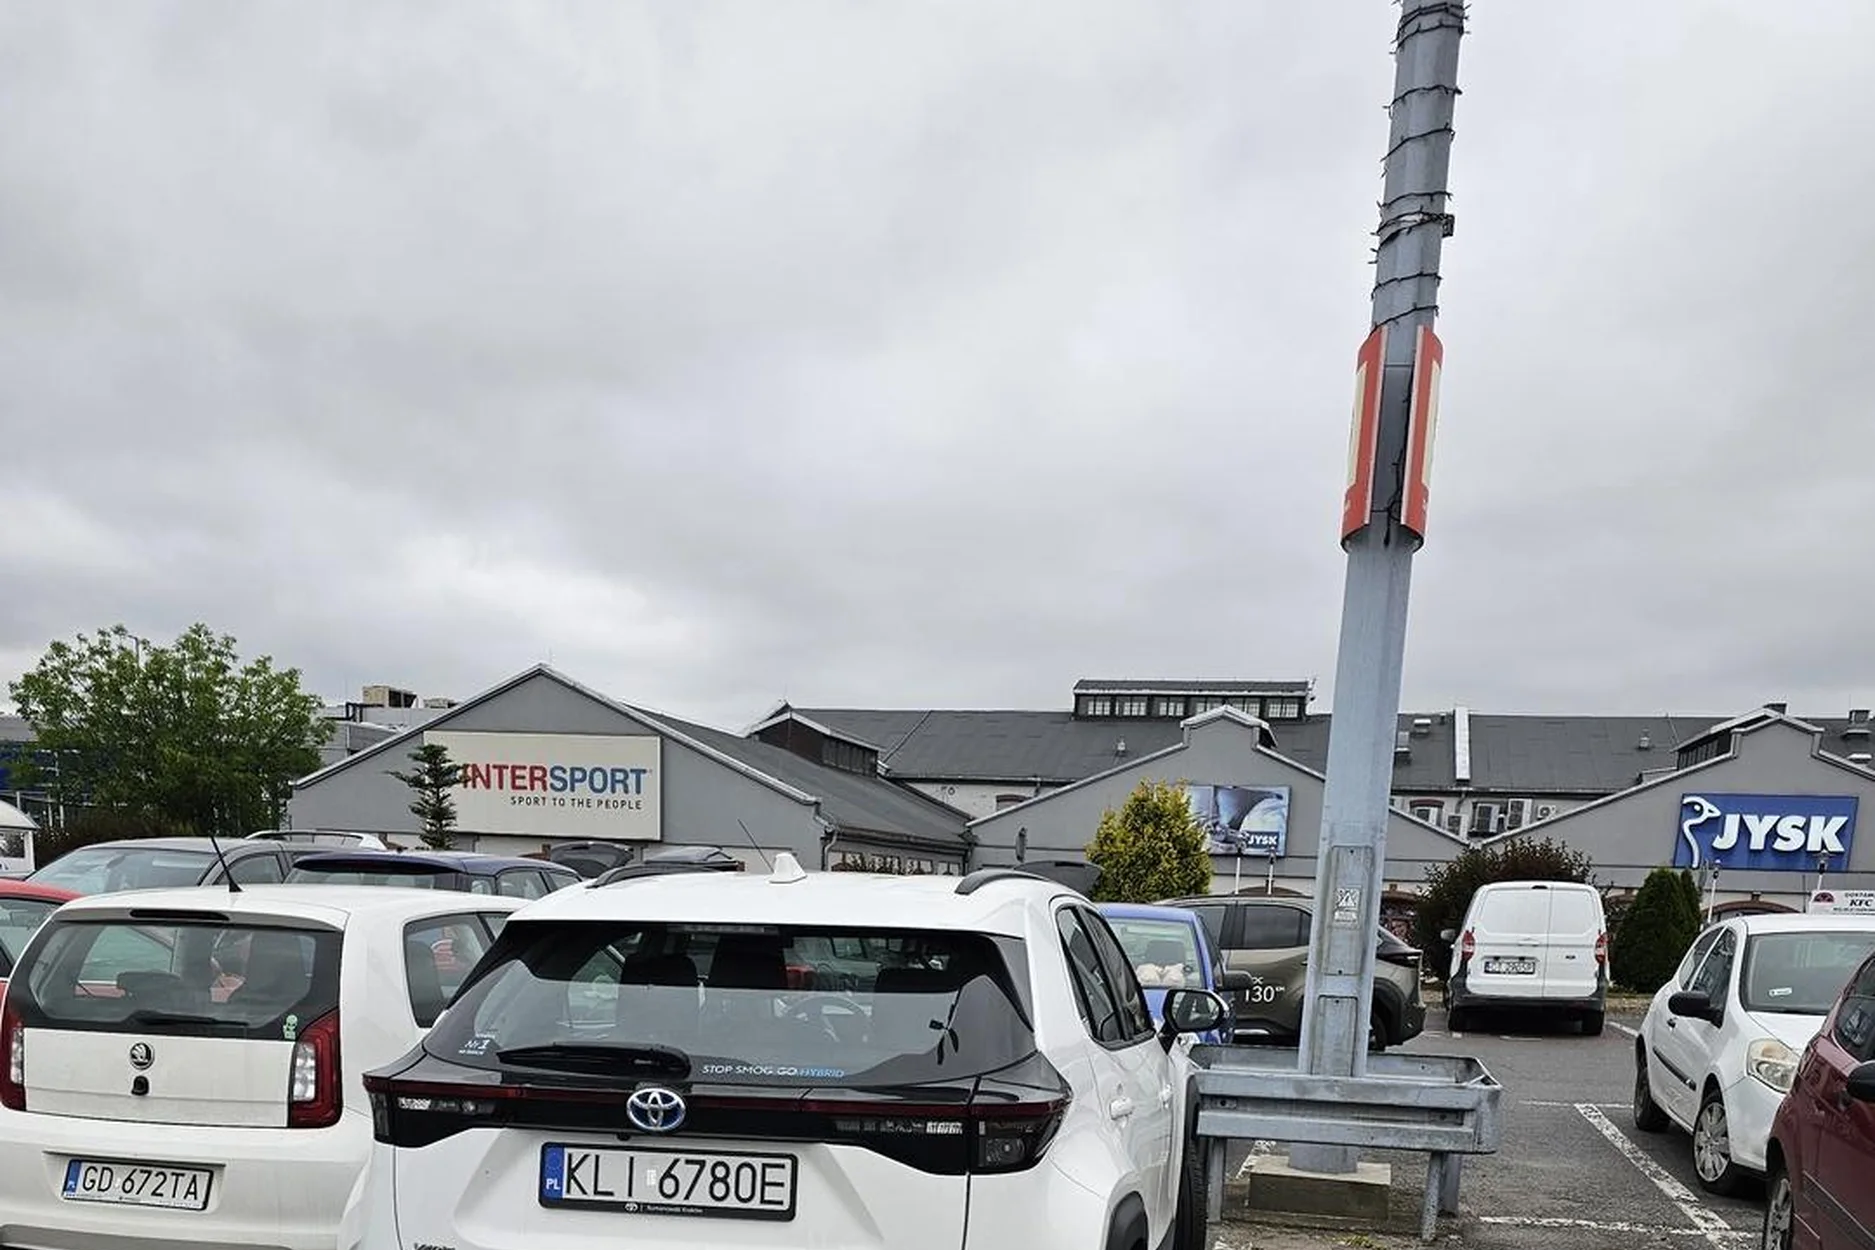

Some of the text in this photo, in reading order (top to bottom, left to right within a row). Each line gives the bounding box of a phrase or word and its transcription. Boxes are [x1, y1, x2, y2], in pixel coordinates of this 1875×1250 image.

[511, 796, 642, 810] SPORT TO THE PEOPLE
[1247, 833, 1278, 845] JYSK
[1712, 813, 1848, 852] JYSK
[702, 1065, 845, 1078] STOP SMOG GO HYBRID
[82, 1166, 198, 1200] GD 672TA
[546, 1179, 561, 1190] PL
[566, 1153, 786, 1206] KLI 6780E
